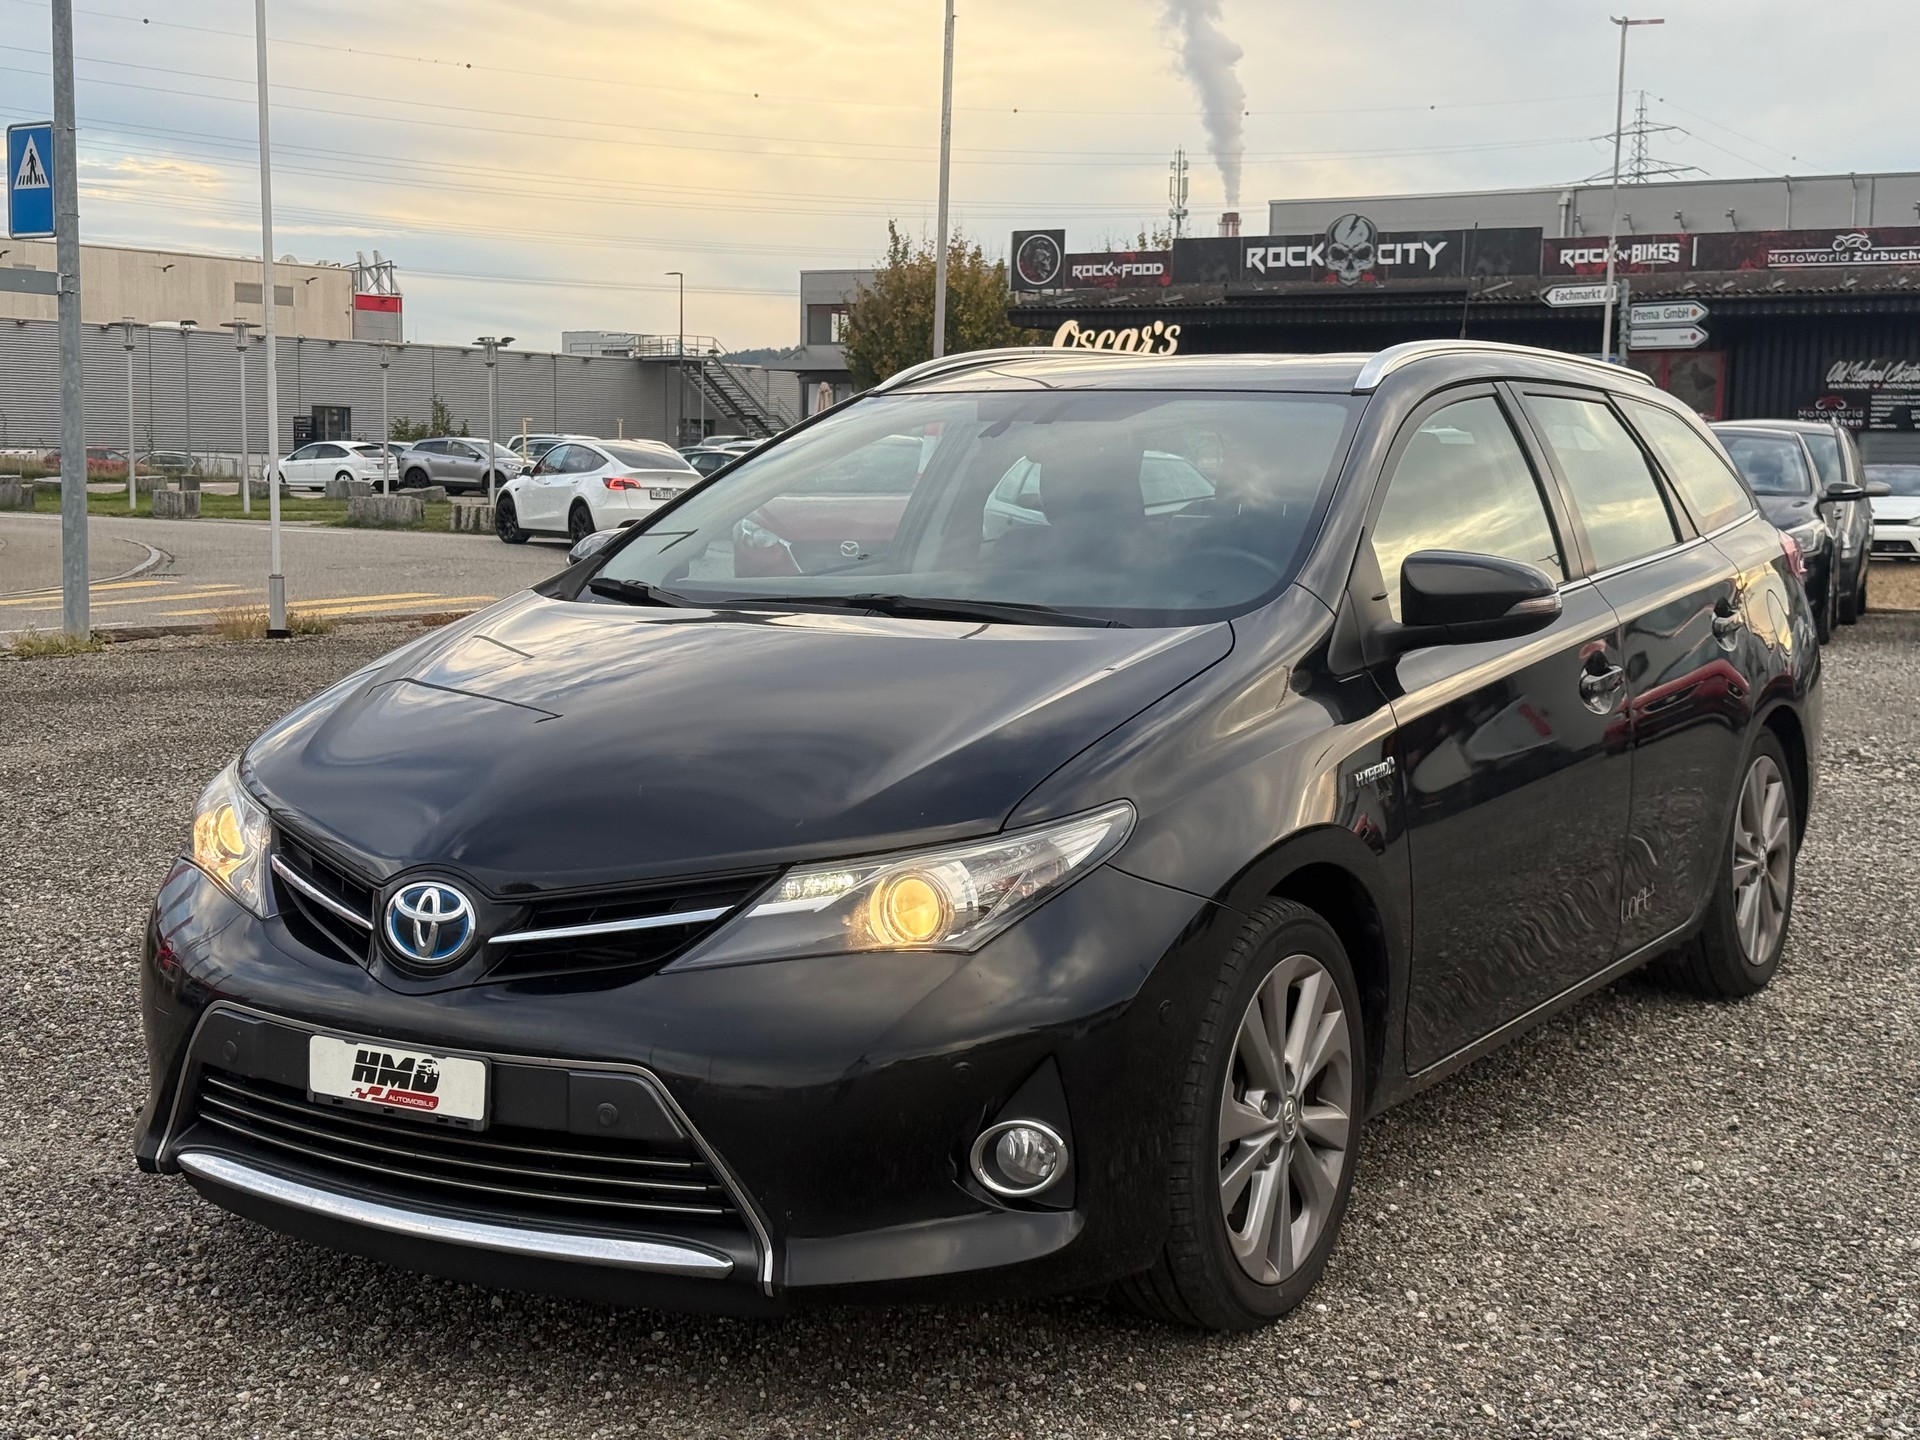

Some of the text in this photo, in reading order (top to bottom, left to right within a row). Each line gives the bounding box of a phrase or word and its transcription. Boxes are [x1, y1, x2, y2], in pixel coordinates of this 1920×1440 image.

[1246, 241, 1448, 274] ROCK CITY
[1767, 251, 1849, 264] MotoWorld
[1555, 288, 1601, 301] Fachmarkt
[1633, 307, 1689, 321] Prema GmbH
[1052, 319, 1181, 356] Oscar's
[351, 1049, 440, 1094] HMD
[388, 1094, 435, 1108] AUTOMOBILE
